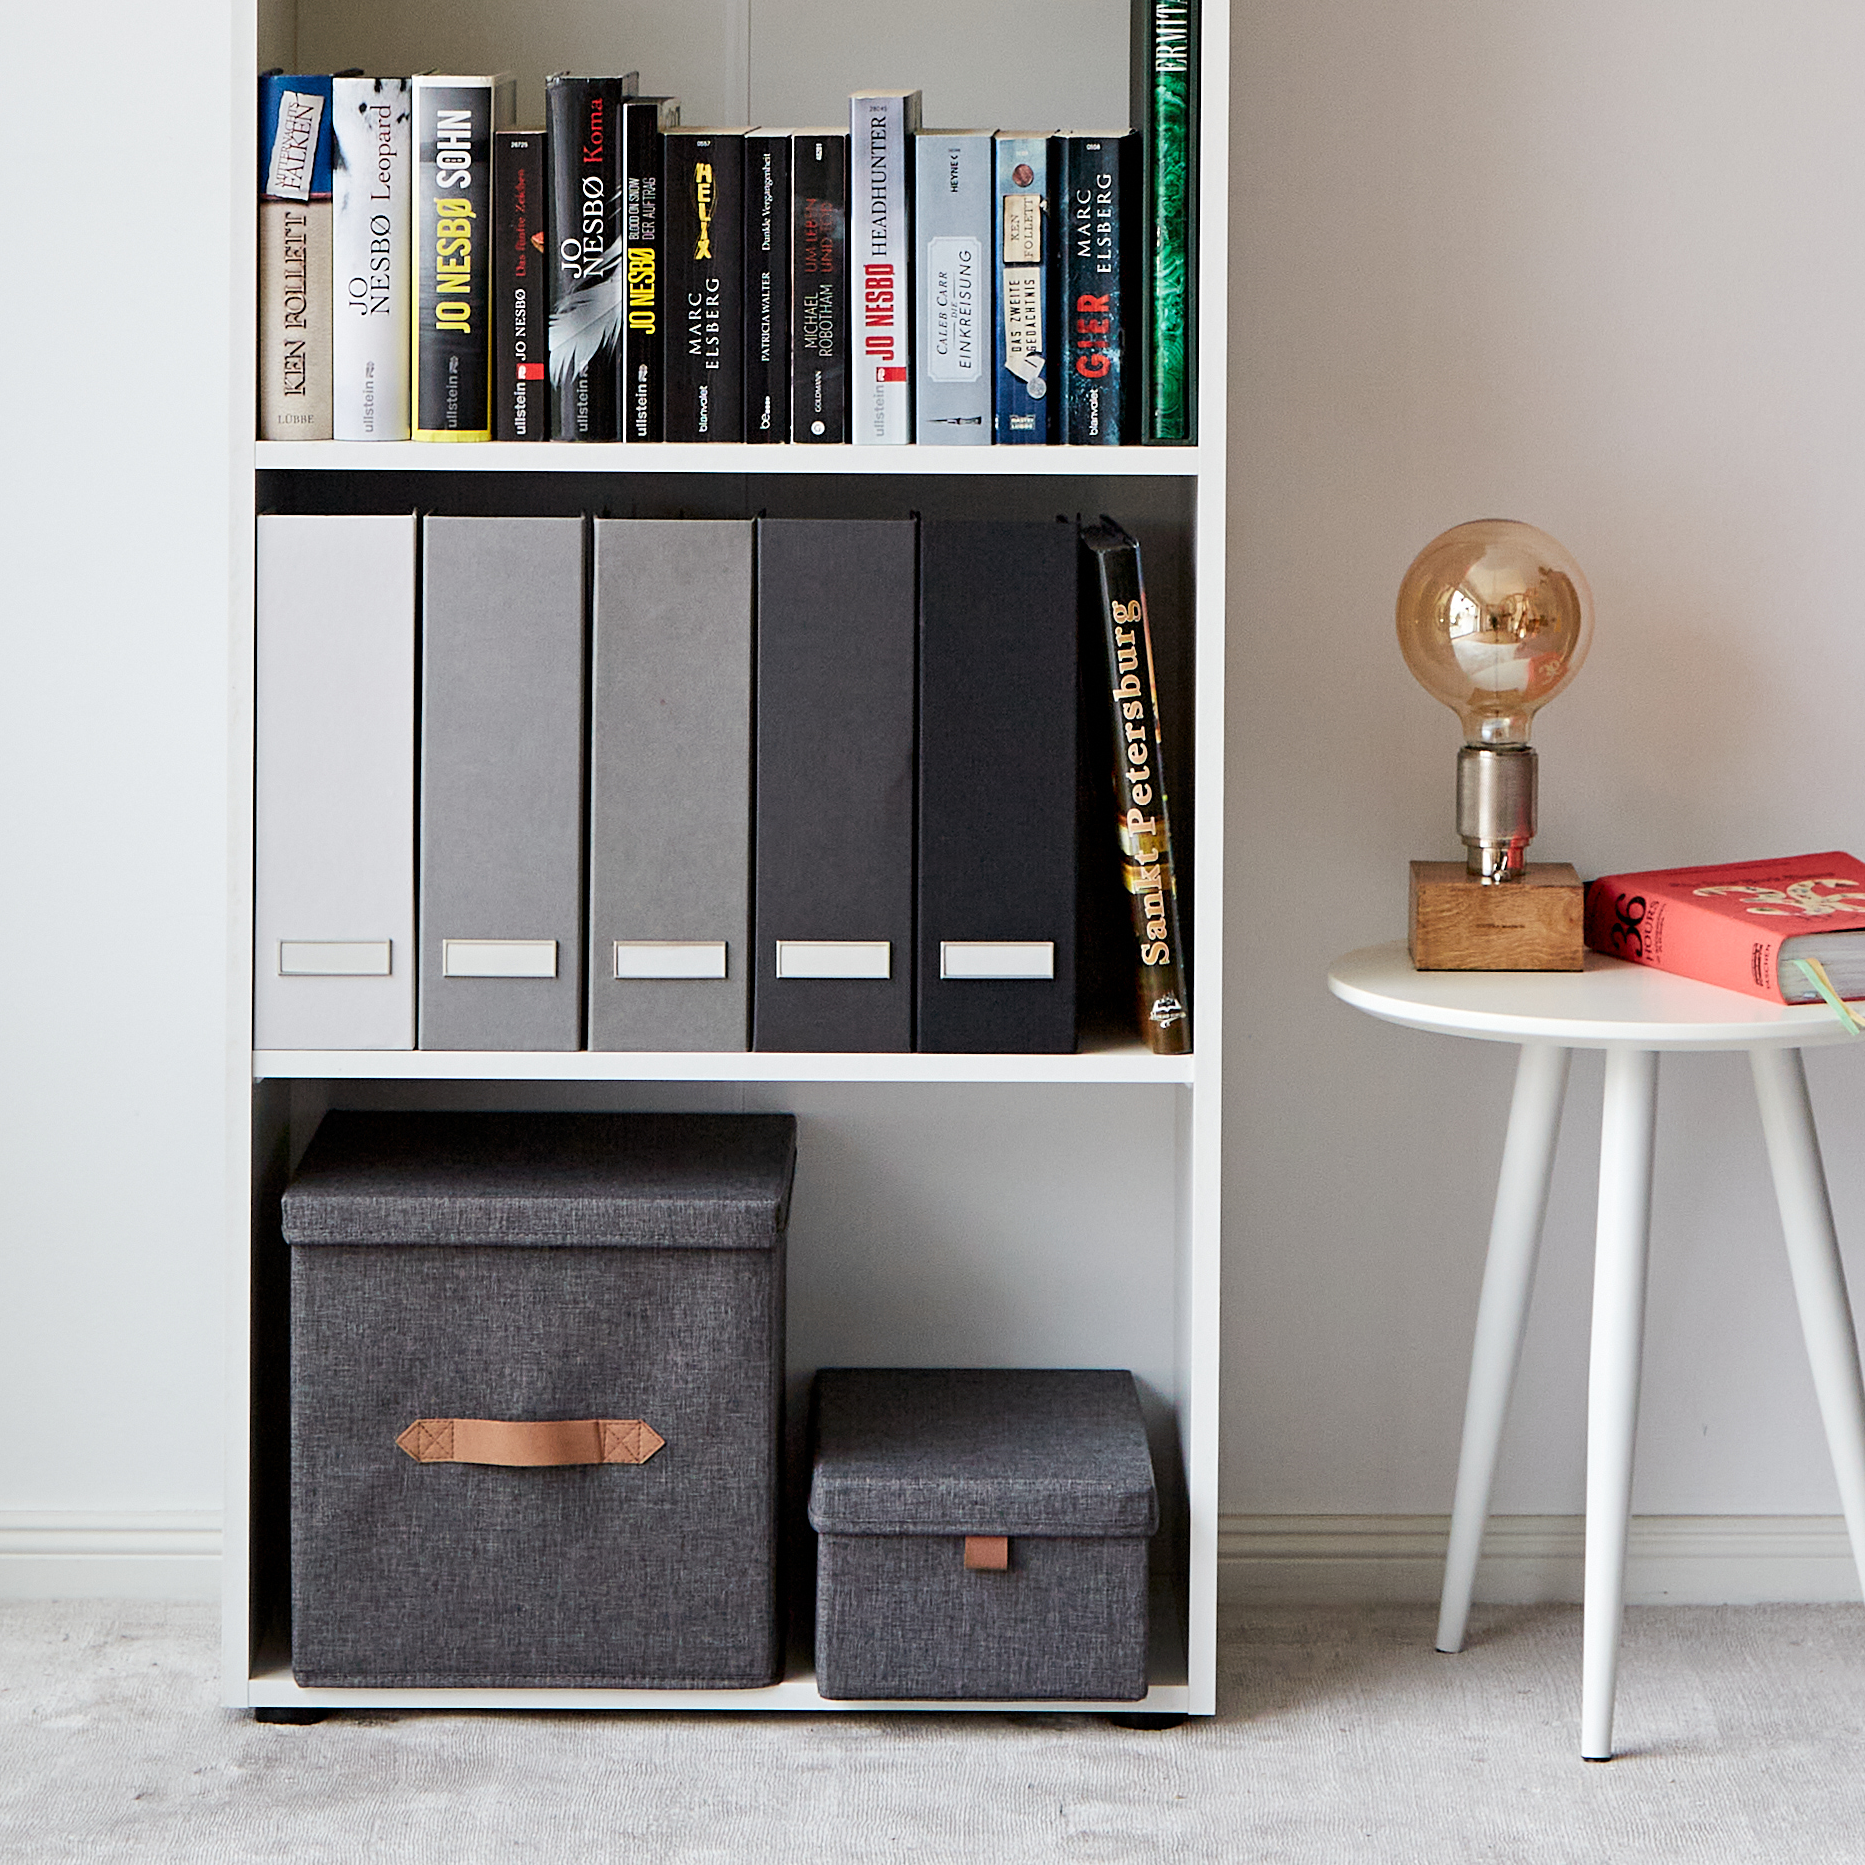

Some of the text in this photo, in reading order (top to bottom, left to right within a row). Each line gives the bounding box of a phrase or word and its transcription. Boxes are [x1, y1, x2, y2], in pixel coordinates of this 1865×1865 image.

[282, 104, 314, 190] FALKEN
[370, 105, 397, 316] NESBØ Leopard
[582, 97, 605, 279] NESBØ Koma
[628, 177, 640, 202] SNOW
[641, 177, 656, 241] DER AUFTRAG
[695, 162, 713, 260] HELIX
[434, 110, 477, 334] JO NESBØ SOHN
[628, 215, 640, 240] BLOOD
[863, 116, 895, 361] JO NESBØ HEADHUNTER
[1010, 214, 1020, 241] KEN
[1024, 198, 1034, 258] FOLLETT
[1077, 189, 1091, 257] MARC
[1097, 173, 1112, 273] ELSBERG
[515, 254, 527, 277] Das
[560, 238, 582, 280] JO
[761, 153, 774, 362] PATRICIA WALTER Dunkle Vergangenheit
[804, 247, 818, 273] UM
[820, 237, 834, 273] UND
[284, 211, 307, 397] KEN FOLLETT
[348, 277, 369, 316] JO
[515, 288, 527, 337] NESBØ
[628, 247, 656, 335] JO NESBØ
[804, 292, 819, 349] MICHAEL
[819, 284, 834, 357] ROBOTHAM
[936, 271, 948, 355] CALEB CARR
[959, 250, 972, 369] EINKREISUNG
[1009, 279, 1022, 352] DAS ZWEITE
[515, 341, 527, 362] JO
[688, 292, 702, 355] MARC
[705, 278, 720, 370] ELSBERG
[1076, 294, 1112, 378] GIER
[278, 413, 315, 425] LÜBBE
[363, 380, 375, 433] ullstein
[446, 376, 459, 429] ullstein
[514, 382, 527, 435] ullstein
[576, 379, 589, 433] ullstein
[635, 384, 648, 437] ullstein
[699, 385, 709, 433] blanvalet
[873, 385, 885, 437] ullstein
[1089, 387, 1099, 436] blanvalet
[1111, 599, 1158, 838] Petersburg
[1133, 848, 1171, 966] Sankt
[1611, 893, 1647, 958] 36
[1644, 900, 1660, 962] HOURS
